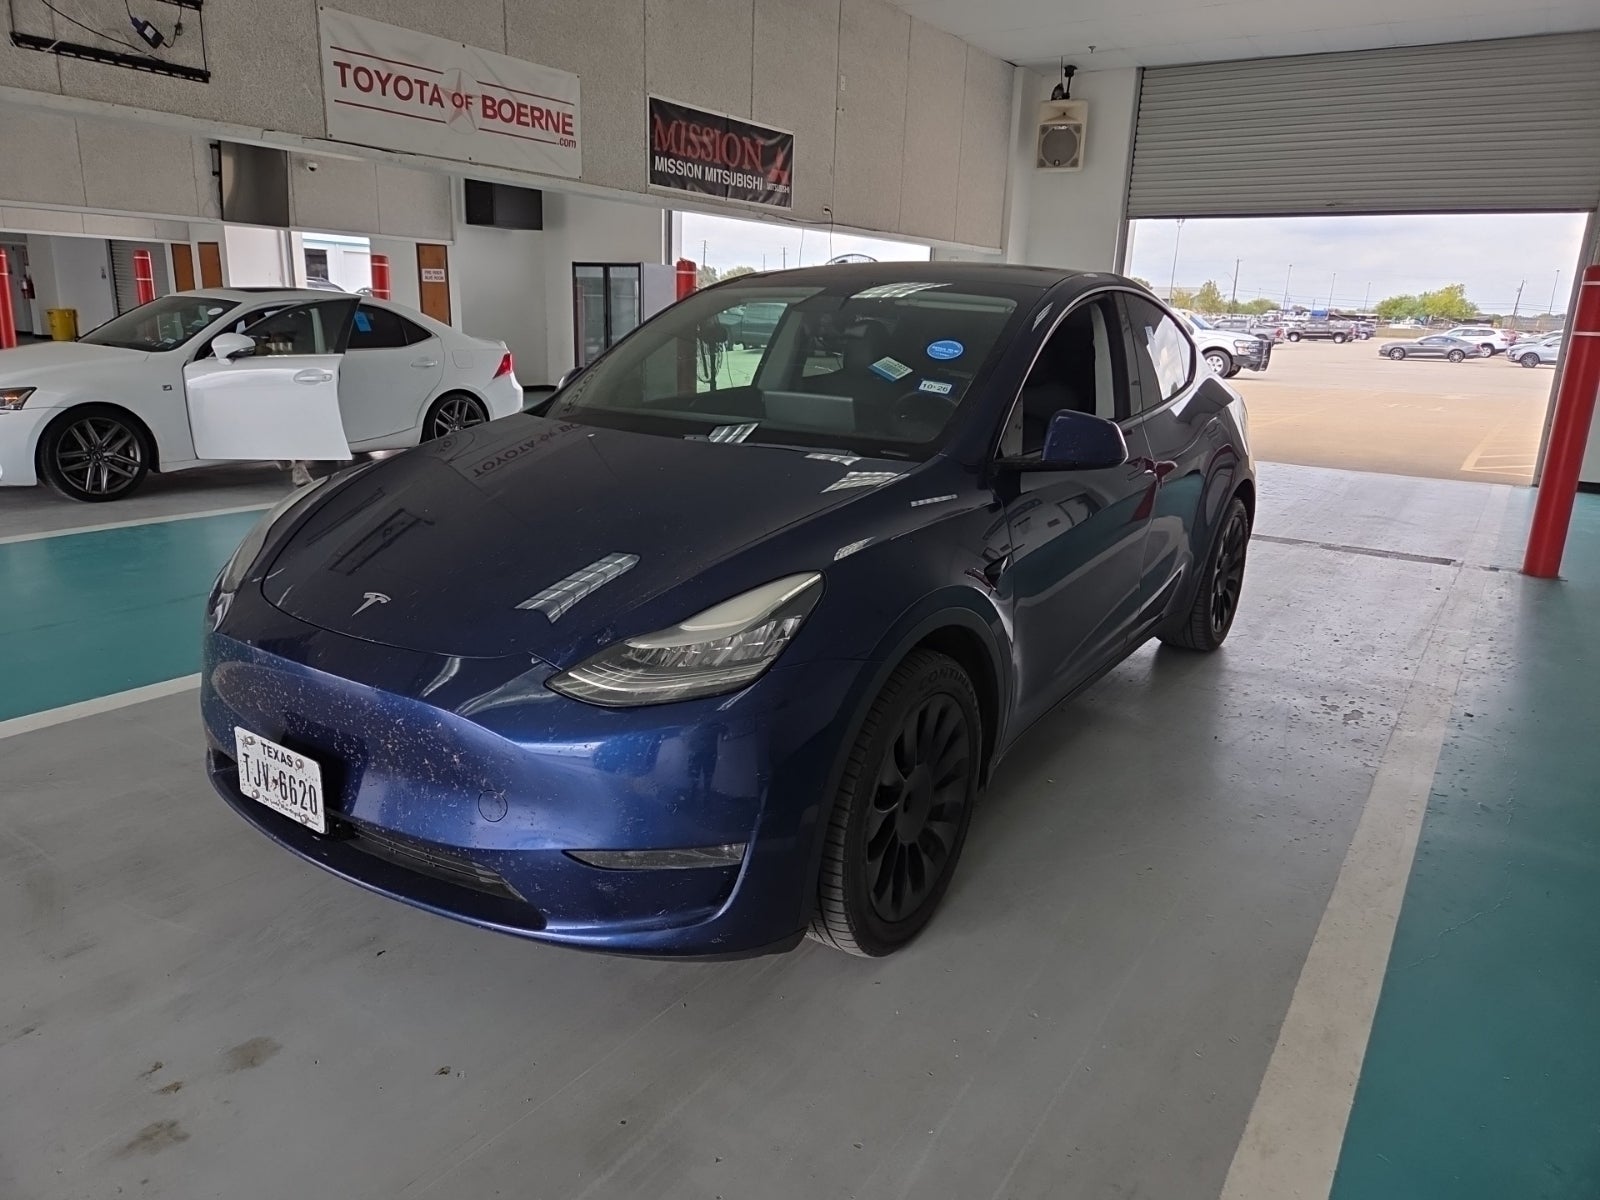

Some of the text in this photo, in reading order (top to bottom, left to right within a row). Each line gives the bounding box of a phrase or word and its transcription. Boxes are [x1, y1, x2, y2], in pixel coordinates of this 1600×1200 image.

[333, 60, 574, 136] TOYOTA OF BOERNE
[556, 137, 577, 149] .com
[653, 113, 765, 173] MISSION
[655, 155, 763, 190] MISSION MITSUBISHI
[261, 742, 293, 767] TEXAS
